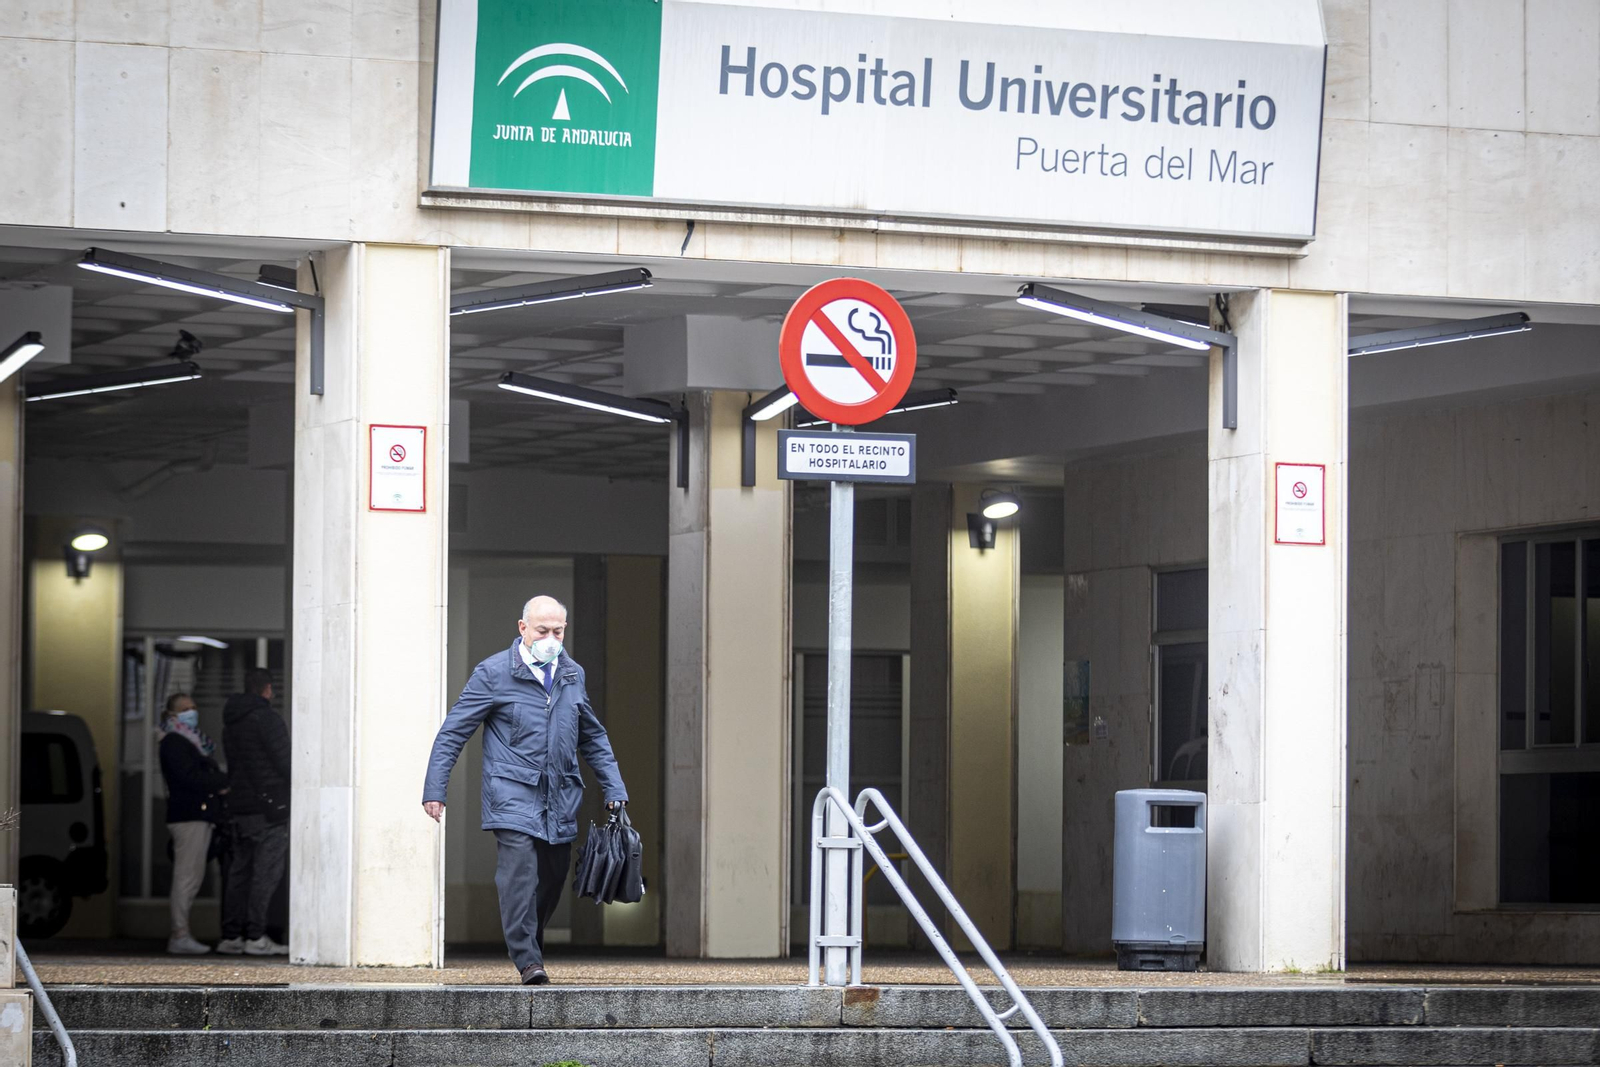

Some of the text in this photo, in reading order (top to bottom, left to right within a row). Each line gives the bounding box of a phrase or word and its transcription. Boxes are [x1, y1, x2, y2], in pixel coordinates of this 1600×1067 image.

[720, 45, 1277, 131] Hospital Universitario
[493, 124, 632, 148] JUNTA DE ANDALUCIA
[1016, 136, 1274, 186] Puerta del Mar
[791, 442, 905, 457] EN TODO EL RECINTO
[809, 457, 887, 470] HOSPITALARIO
